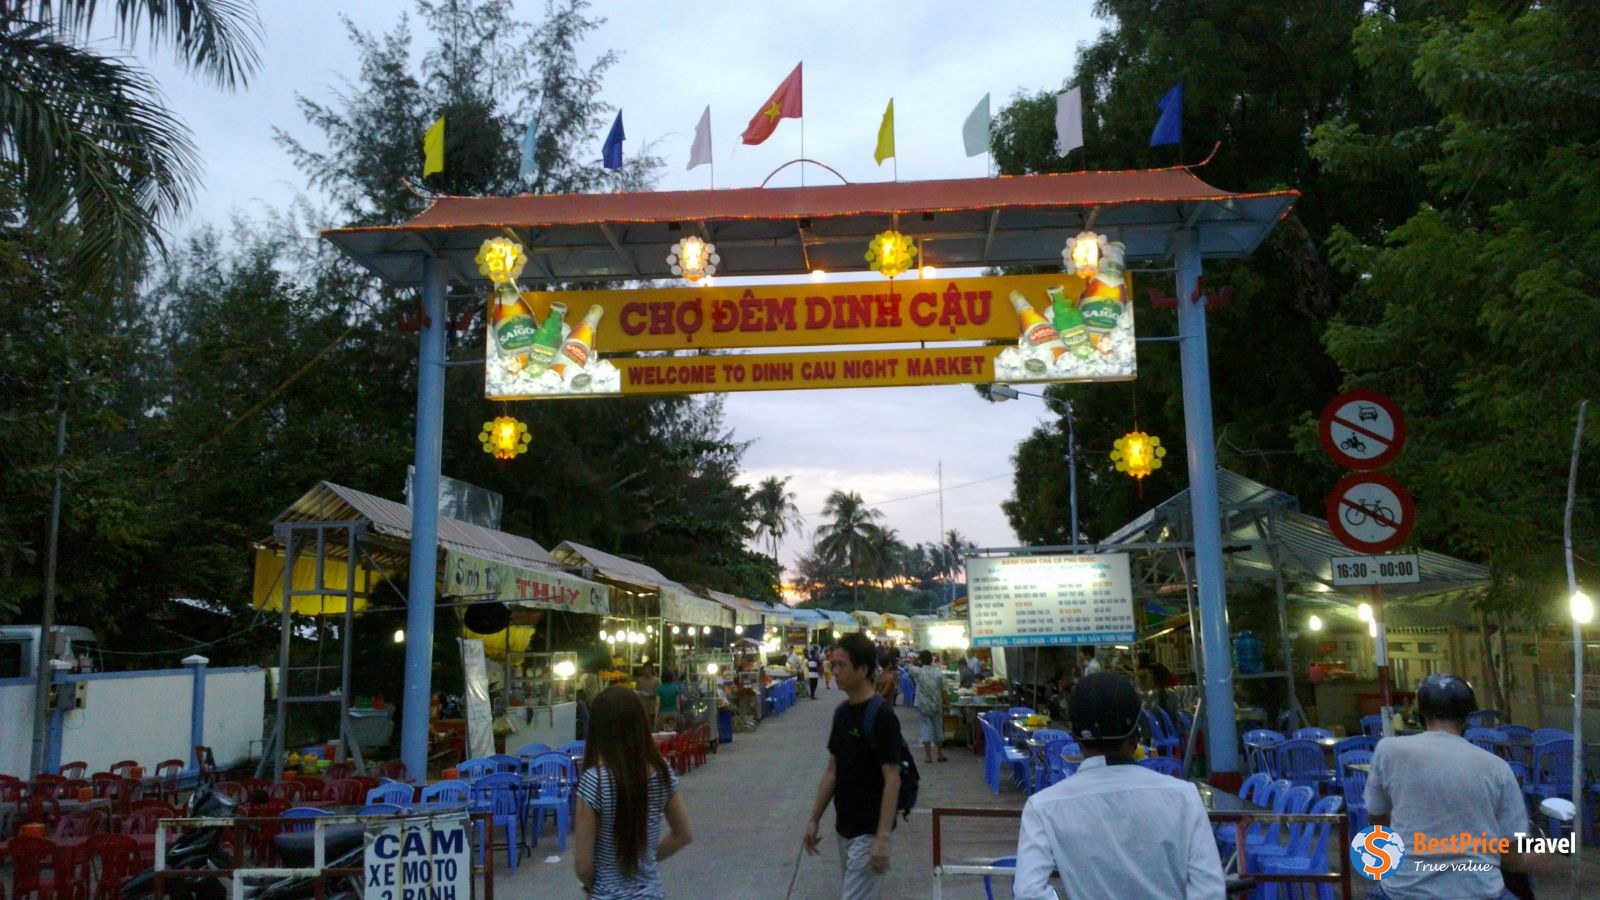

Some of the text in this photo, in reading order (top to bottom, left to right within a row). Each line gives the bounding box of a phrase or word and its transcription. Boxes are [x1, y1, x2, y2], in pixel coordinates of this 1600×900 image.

[620, 281, 992, 343] CHỢ ĐÊM DINH CẬU
[1082, 309, 1121, 321] SAIGO
[499, 326, 536, 345] SAIGO
[628, 355, 985, 385] WELCOME TO DINH CAU NIGHT MARKET
[1336, 562, 1368, 579] 16:30
[1380, 560, 1413, 577] 00:00
[368, 863, 395, 888] XE
